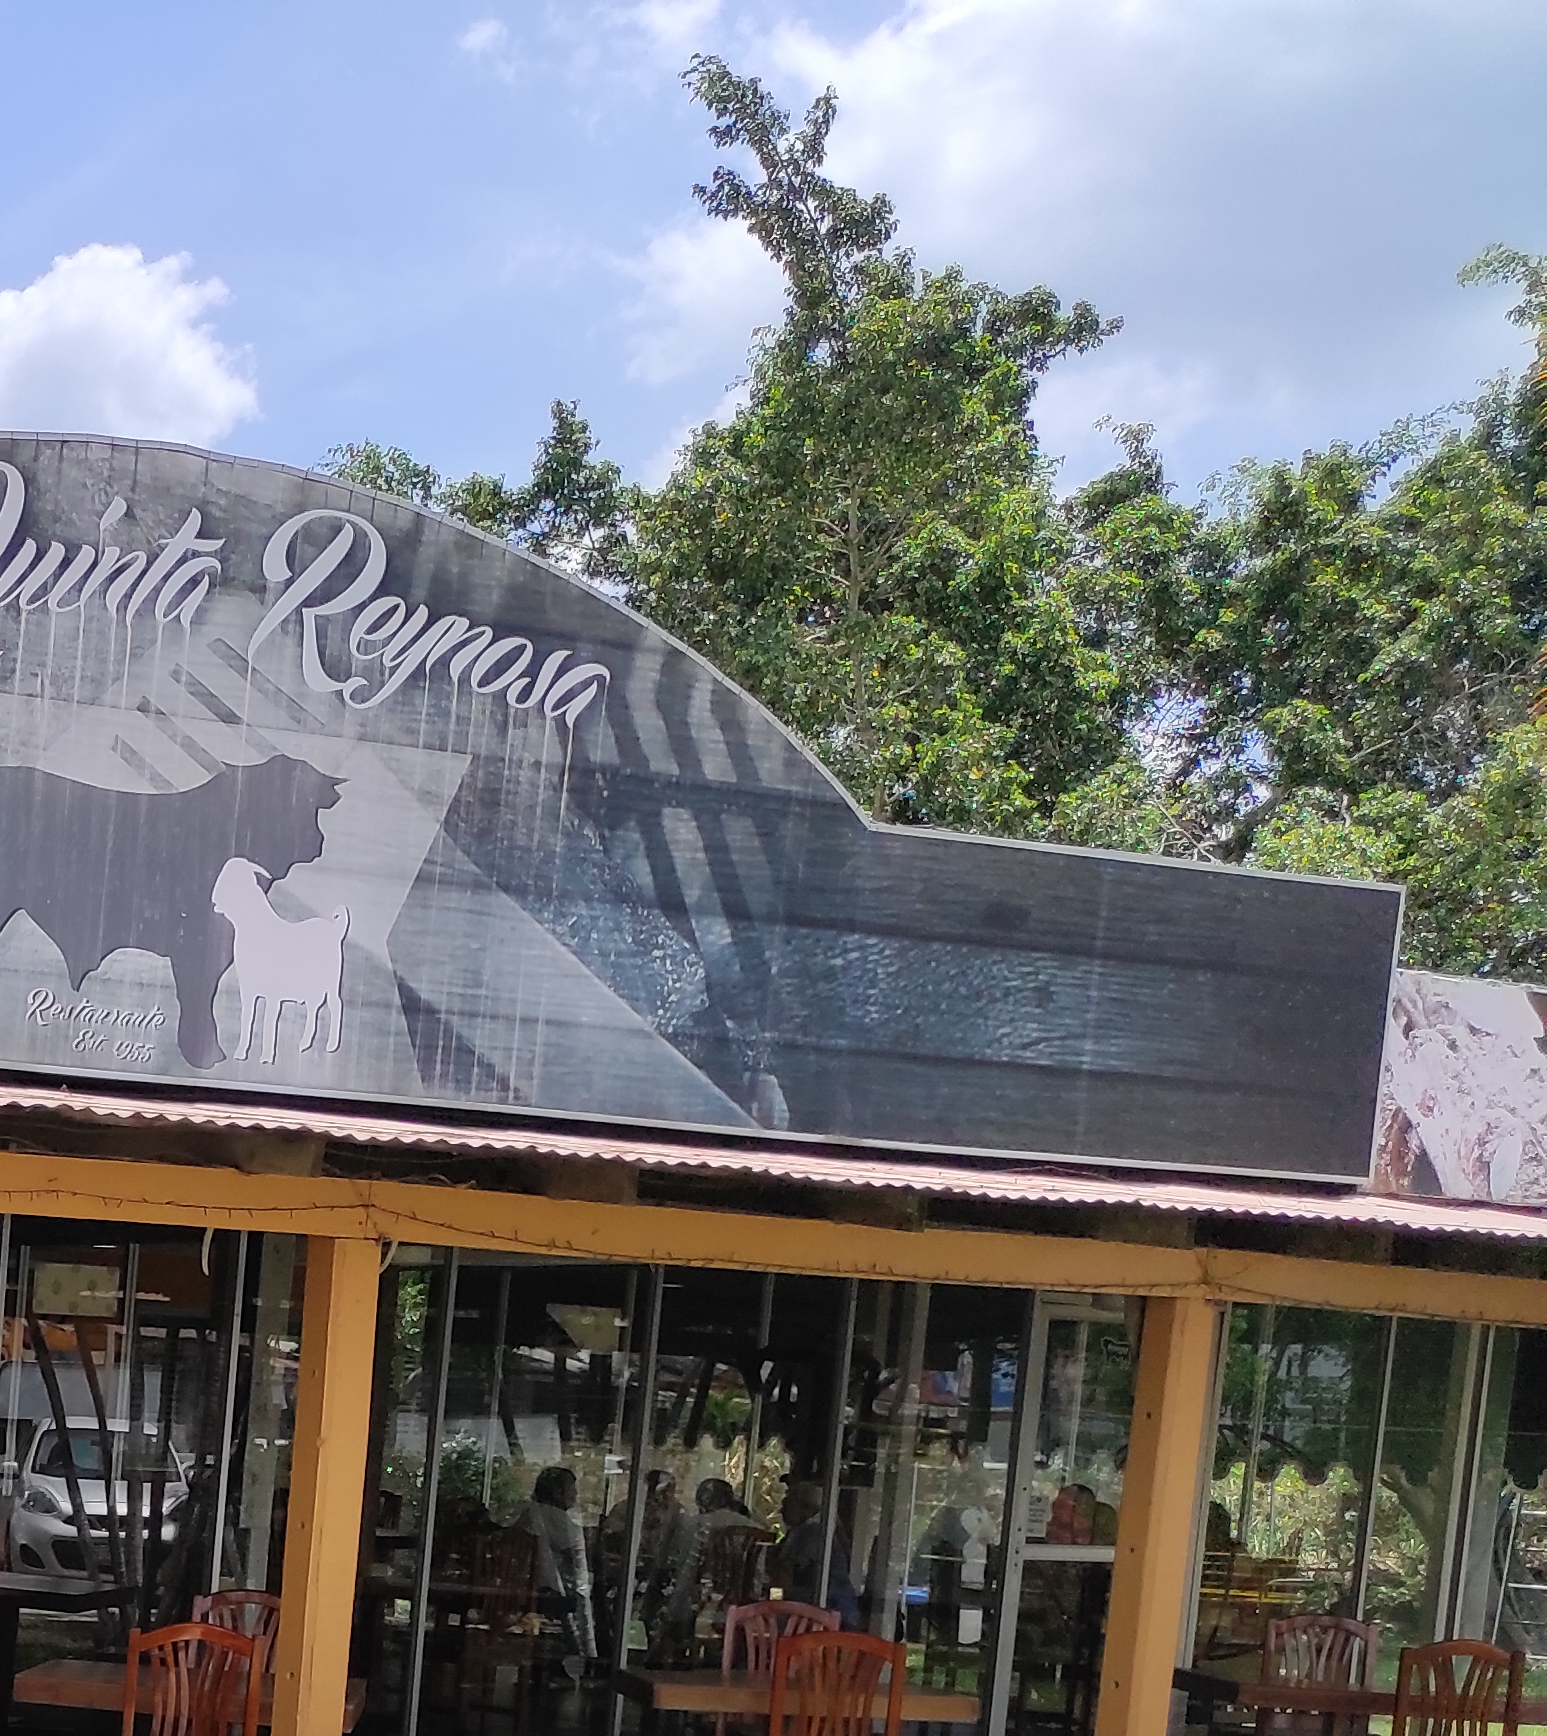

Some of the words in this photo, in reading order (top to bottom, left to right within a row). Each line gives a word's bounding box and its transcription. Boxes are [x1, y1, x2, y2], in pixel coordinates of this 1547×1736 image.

[248, 509, 613, 728] Reynosa
[26, 987, 168, 1031] Restaurante
[72, 1029, 109, 1053] Est.
[112, 1040, 156, 1064] 1955
